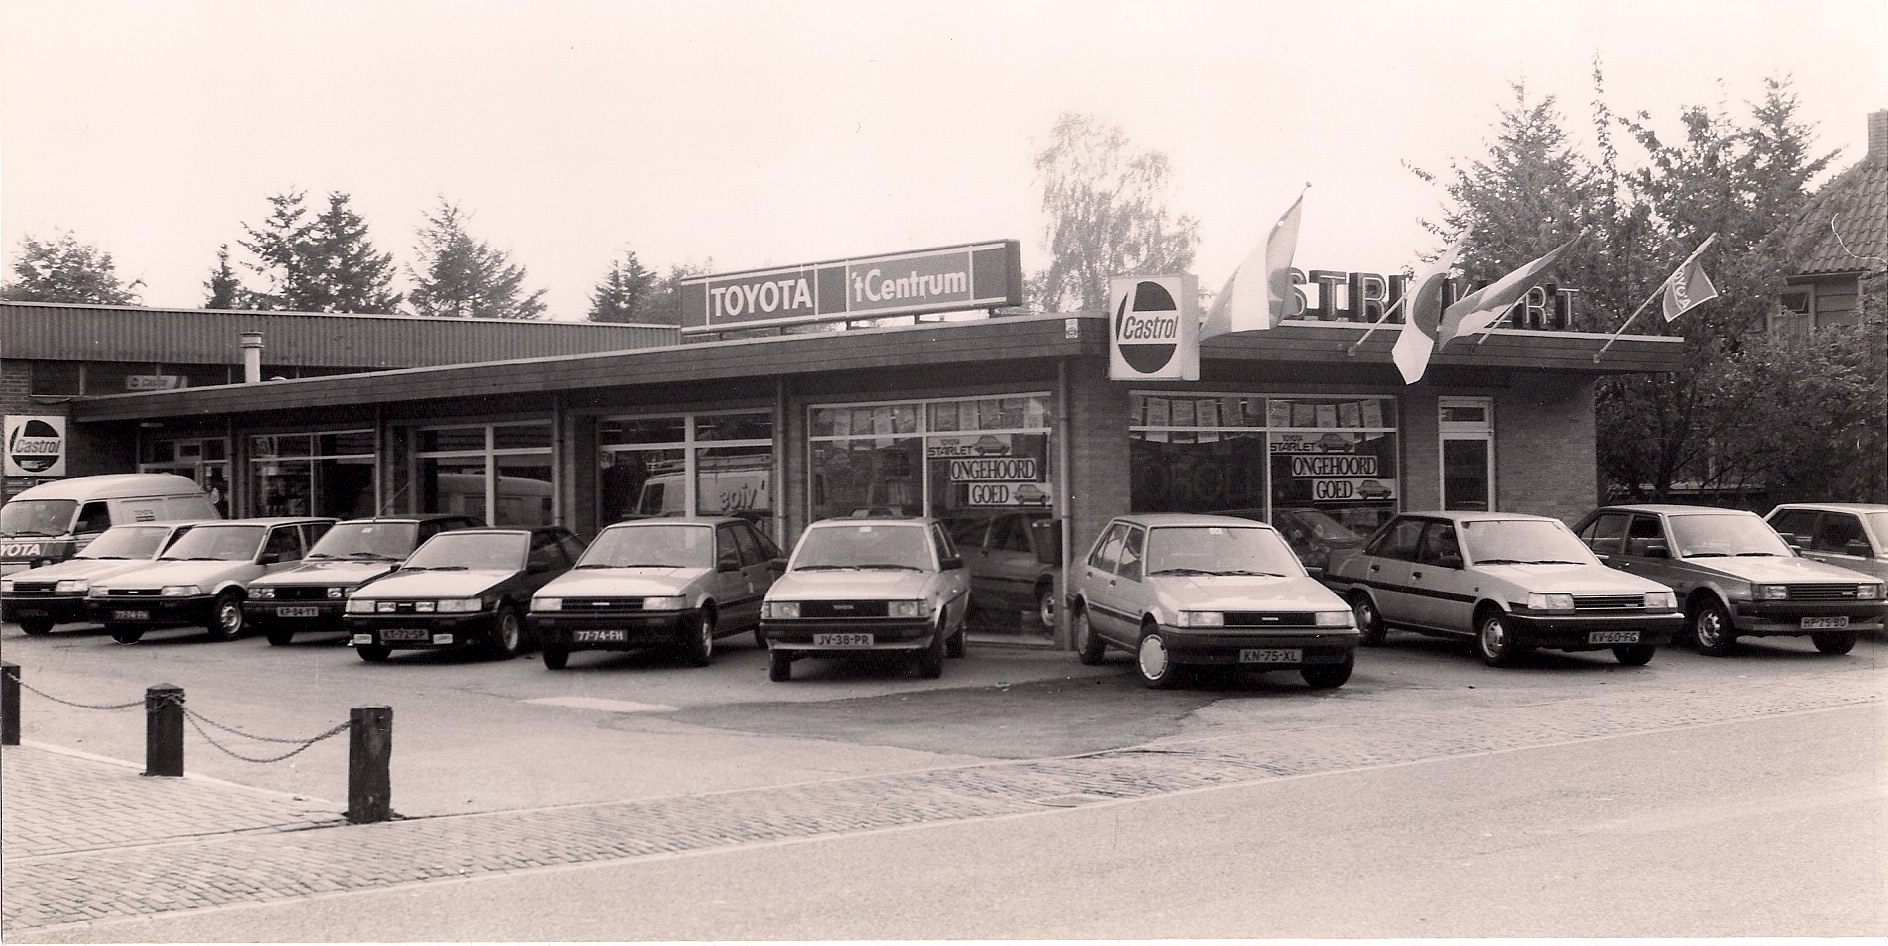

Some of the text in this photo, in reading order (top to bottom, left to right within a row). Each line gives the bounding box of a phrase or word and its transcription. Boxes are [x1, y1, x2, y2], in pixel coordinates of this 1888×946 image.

[710, 278, 814, 317] TOYOTA
[1123, 315, 1179, 340] Castrol
[15, 439, 61, 454] Castrol
[928, 445, 973, 456] STARLET
[1270, 442, 1317, 452] STARLET
[952, 459, 1036, 480] ONGEHOORD
[1293, 457, 1377, 476] ONGEHOORD
[972, 484, 1009, 504] GOED
[1316, 480, 1353, 499] GOED
[577, 630, 624, 642] 77-74-FH
[817, 634, 870, 646] JV-38-PR
[1591, 632, 1638, 643] KV-60-FG
[1243, 650, 1299, 662] KN-75-XL
